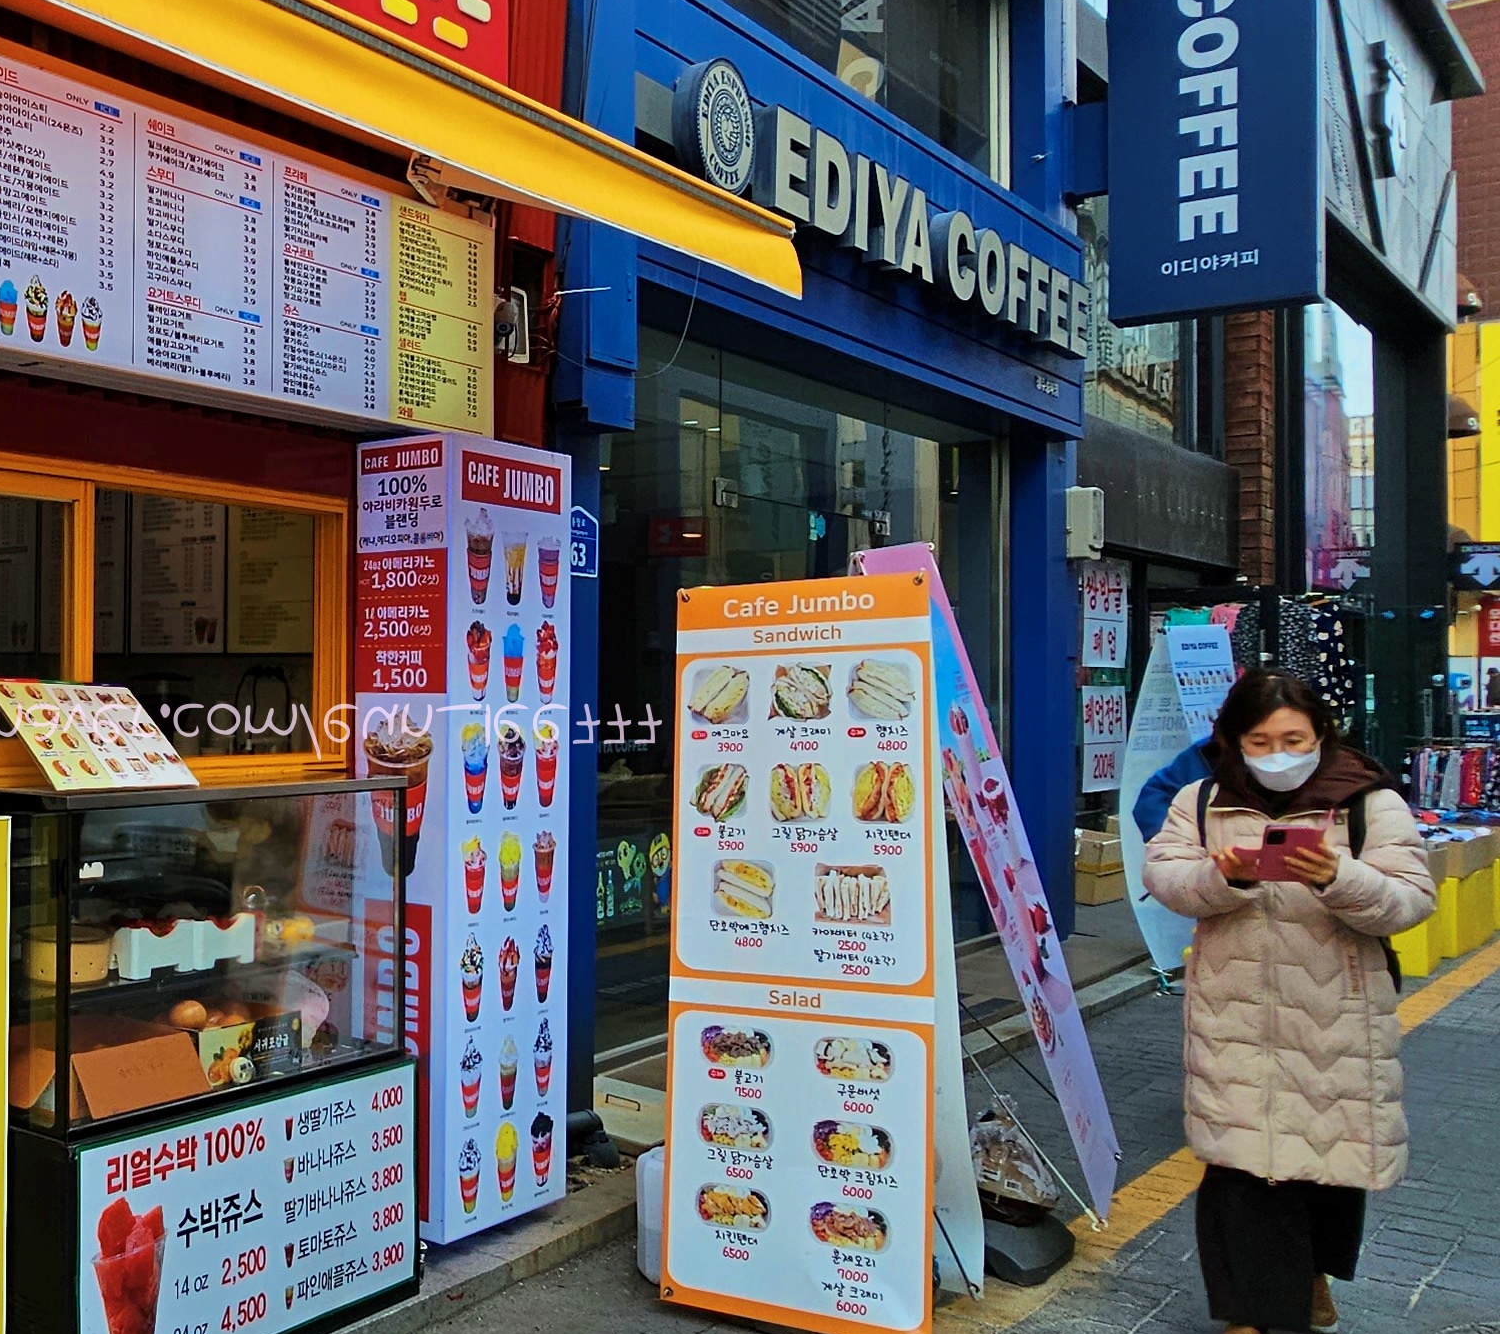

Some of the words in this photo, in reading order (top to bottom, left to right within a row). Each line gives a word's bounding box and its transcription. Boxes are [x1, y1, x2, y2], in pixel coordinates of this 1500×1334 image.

[66, 93, 89, 106] ONLY
[702, 73, 720, 119] EDIYA
[148, 166, 175, 185] 스무디
[709, 153, 740, 185] COFFEE
[769, 104, 933, 284] EDIYA
[941, 210, 1089, 357] COFFEE
[1160, 248, 1260, 278] 이디야커피
[364, 455, 389, 470] CAFE
[395, 448, 439, 468] JUMBO
[378, 475, 427, 497] 100%
[468, 461, 500, 487] CAFE
[503, 468, 554, 506] JUMBO
[363, 495, 443, 513] 아라비카원두로
[384, 513, 418, 529] 블랜딩
[383, 556, 435, 569] 아메리카노
[377, 606, 429, 619] 아메리카노
[724, 595, 779, 620] Cafe
[787, 590, 875, 616] Jumbo
[753, 625, 841, 644] Sandwich
[376, 649, 422, 665] 착한커피
[372, 668, 427, 689] 1,500
[711, 729, 749, 739] 에그마요
[876, 724, 909, 738] 햄치즈
[717, 743, 743, 753] 3900
[877, 740, 907, 751] 4800
[718, 826, 745, 838] 불고기
[773, 827, 791, 838] 그릴
[795, 827, 838, 841] 닭가슴살
[865, 829, 911, 841] 치킨텐더
[718, 841, 744, 851] 5900
[790, 843, 818, 853] 5900
[873, 844, 902, 855] 5900
[812, 927, 857, 938] 카야버터
[734, 937, 762, 947] 4800
[837, 940, 866, 951] 2500
[769, 990, 822, 1009] Salad
[734, 1069, 764, 1084] 불고기
[734, 1087, 762, 1099] 7500
[837, 1084, 880, 1100] 구운버섯
[298, 1100, 356, 1136] 생딸기쥬스
[371, 1085, 403, 1113] 4,000
[843, 1101, 874, 1114] 6000
[106, 1135, 198, 1194] 리얼수박
[204, 1118, 266, 1169] 100%
[298, 1139, 357, 1176] 바나나쥬스
[372, 1125, 403, 1152] 3,500
[818, 1165, 851, 1181] 단호박
[855, 1171, 898, 1188] 크림치즈
[284, 1178, 367, 1223] 딸기바나나쥬스
[371, 1164, 403, 1192] 3,800
[842, 1186, 872, 1199] 6000
[176, 1189, 264, 1247] 수박쥬스
[298, 1221, 358, 1260] 토마토쥬스
[372, 1203, 404, 1231] 3,800
[832, 1249, 876, 1267] 훈제오리
[174, 1279, 189, 1298] 14
[193, 1273, 208, 1292] oz
[221, 1246, 267, 1286] 2,500
[297, 1258, 369, 1302] 파인애플쥬스
[372, 1241, 405, 1272] 3,900
[837, 1269, 868, 1283] 7000
[220, 1293, 267, 1333] 4,500
